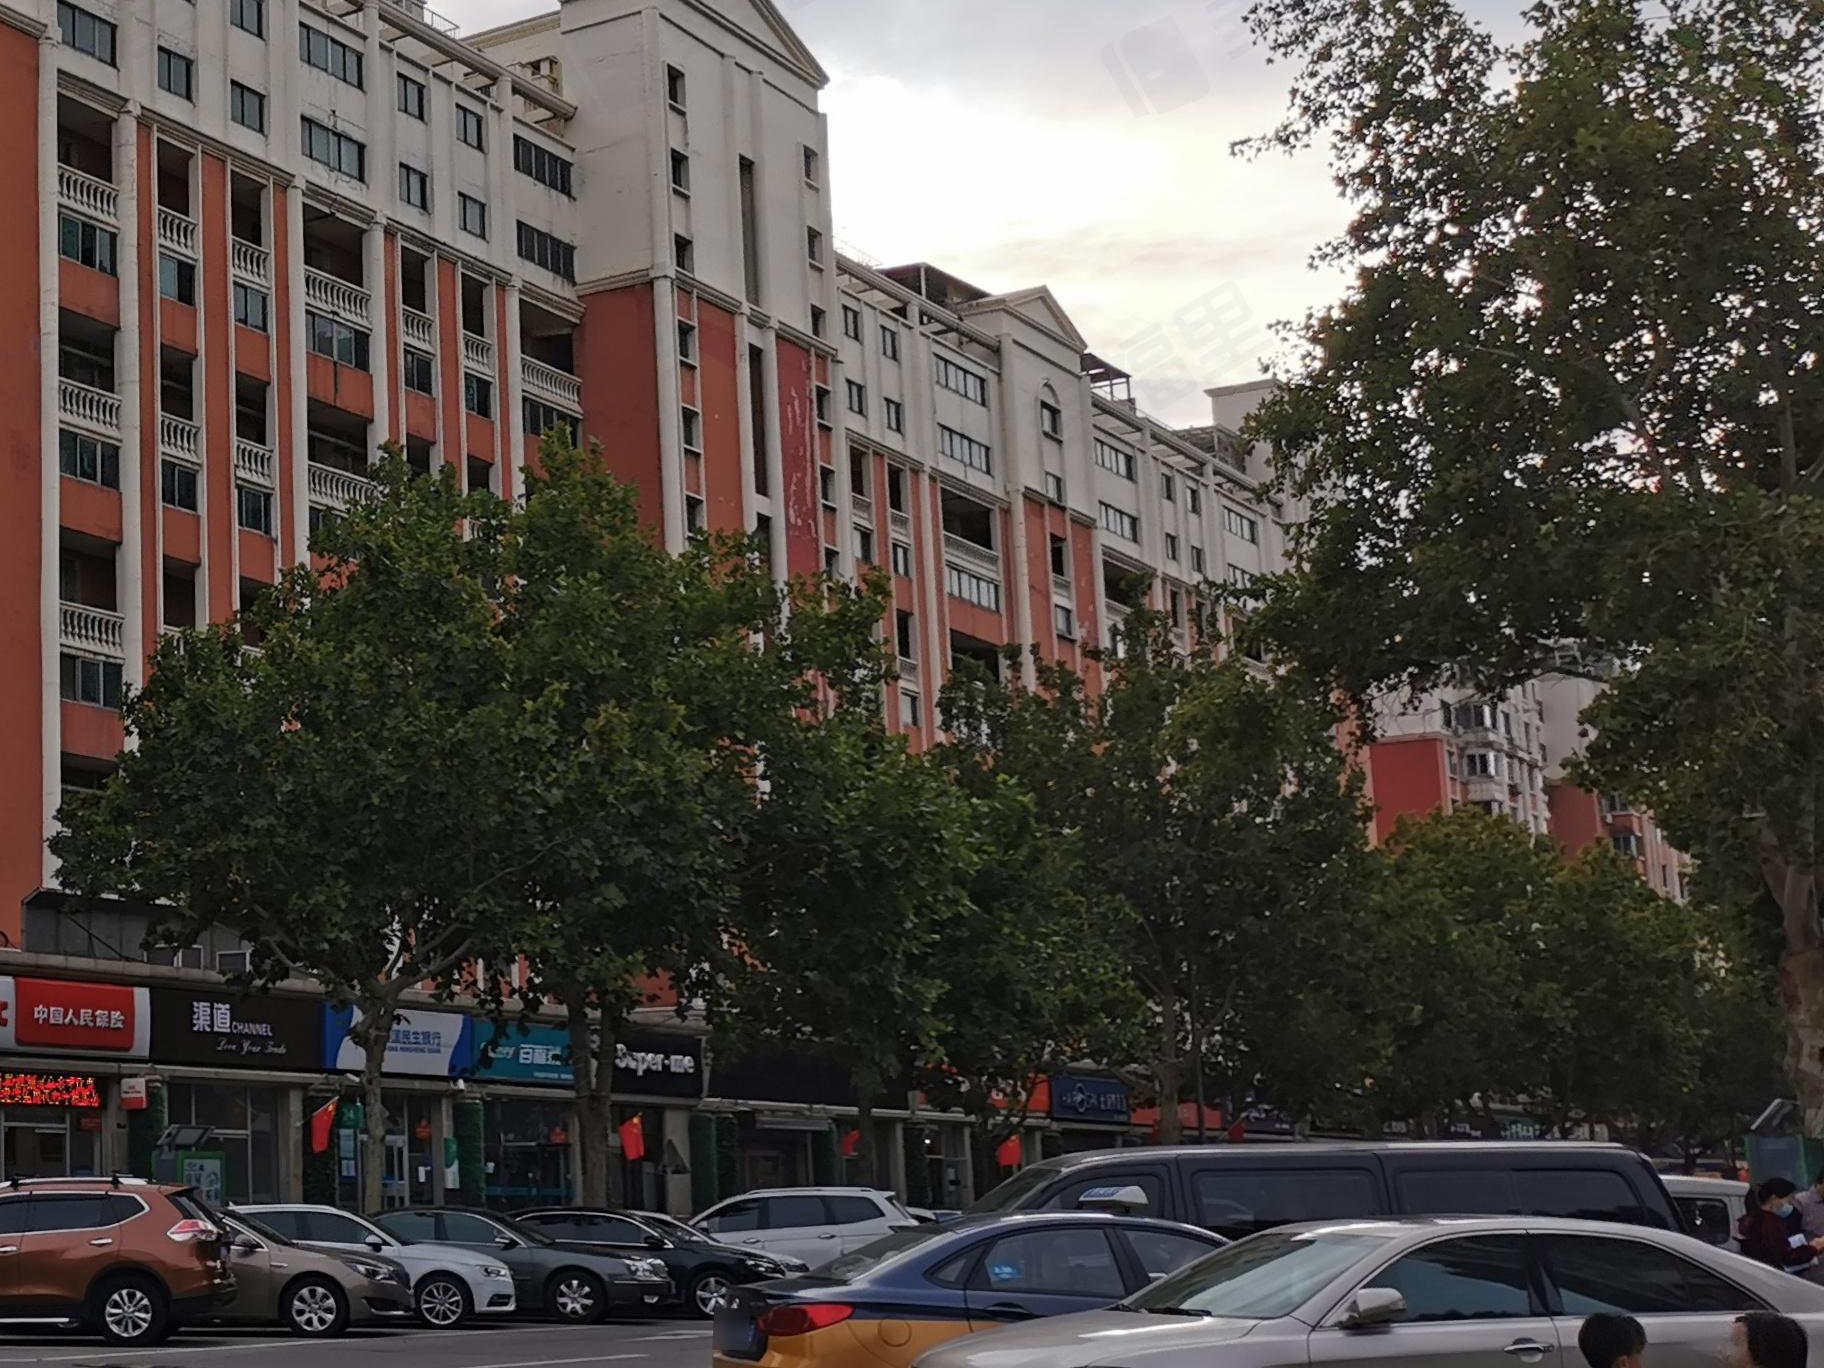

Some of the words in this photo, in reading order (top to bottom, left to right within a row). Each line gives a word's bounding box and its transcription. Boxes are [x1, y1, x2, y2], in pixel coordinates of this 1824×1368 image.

[33, 1004, 126, 1029] 中国人民保险
[192, 1001, 231, 1033] 渠道
